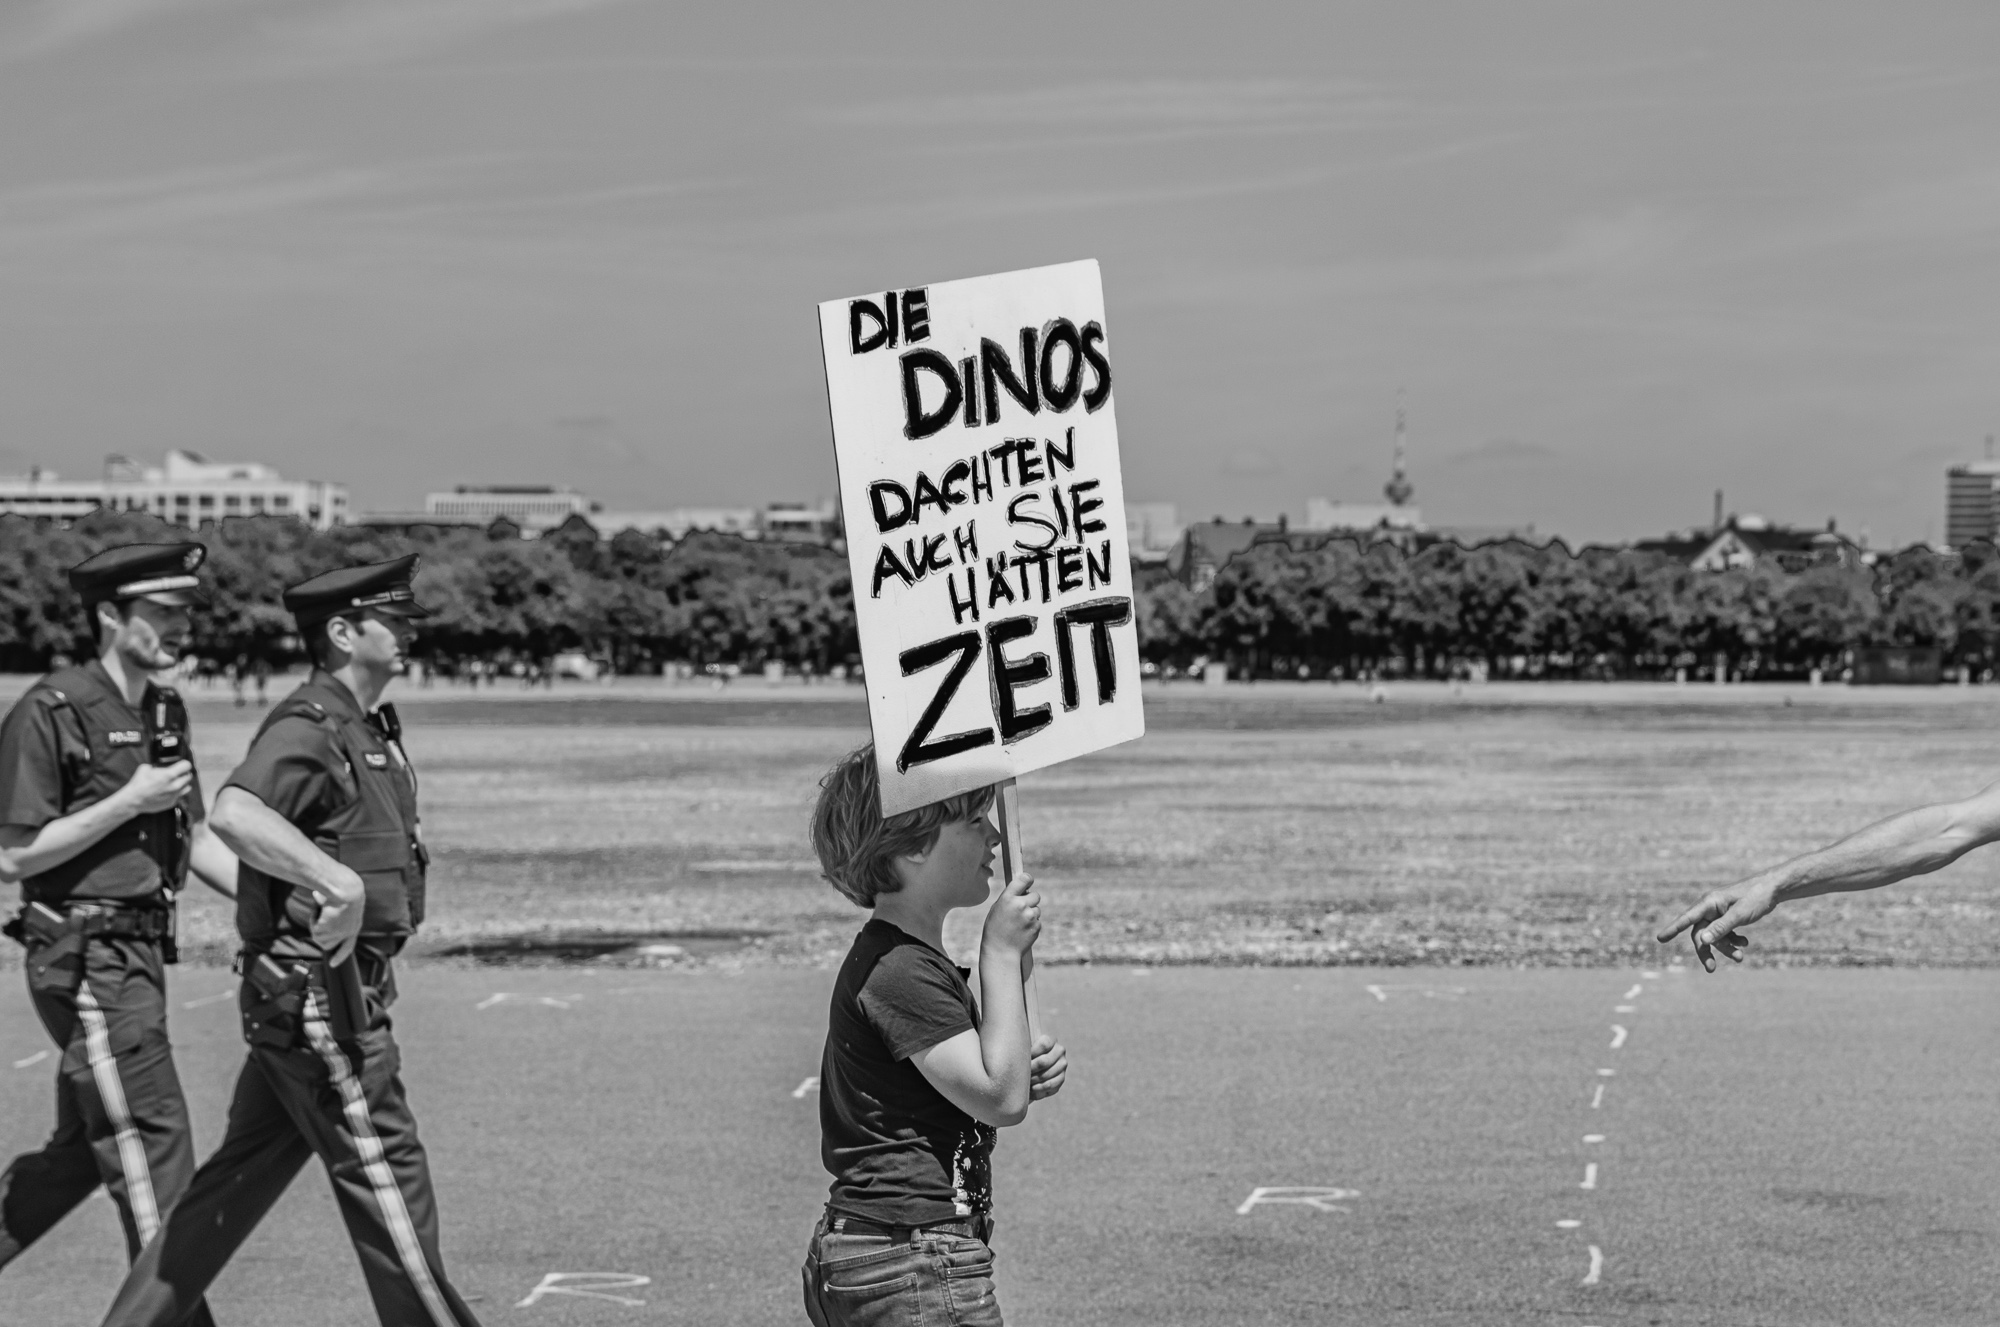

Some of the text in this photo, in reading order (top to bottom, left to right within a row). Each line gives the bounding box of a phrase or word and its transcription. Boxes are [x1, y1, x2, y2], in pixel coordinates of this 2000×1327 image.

[849, 286, 931, 355] DIE
[899, 316, 1112, 440] DINOS
[867, 427, 1075, 534] DACHTEN
[871, 479, 1107, 599] AUCH SIE
[947, 540, 1112, 625] HÄTTEN
[896, 596, 1133, 774] ZEIT
